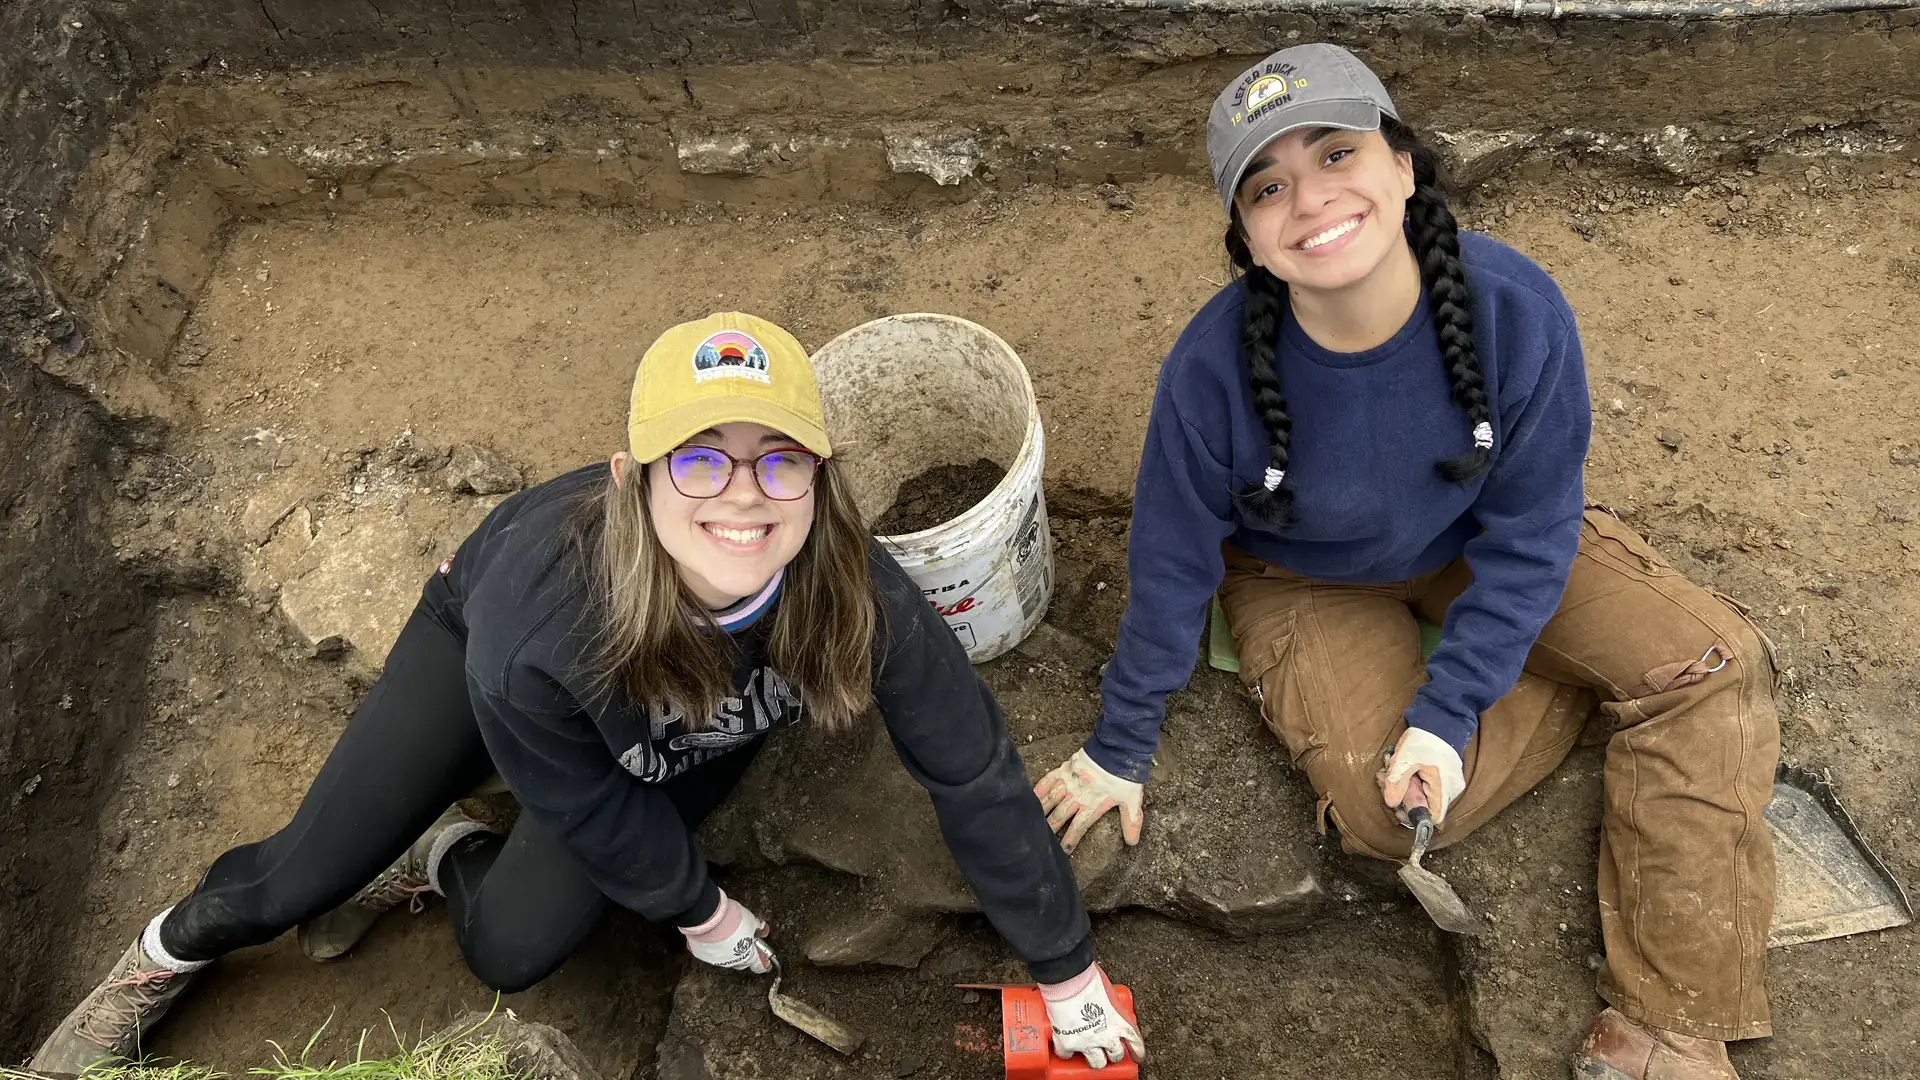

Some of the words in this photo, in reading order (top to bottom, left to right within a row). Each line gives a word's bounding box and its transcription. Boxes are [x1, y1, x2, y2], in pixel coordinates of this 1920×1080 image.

[1265, 62, 1298, 77] BUCK
[1293, 78, 1308, 89] 10
[1247, 94, 1292, 124] OREGON
[1230, 112, 1242, 127] 19
[942, 583, 956, 593] IS
[958, 579, 970, 588] A
[1061, 1020, 1101, 1036] GARDENA
